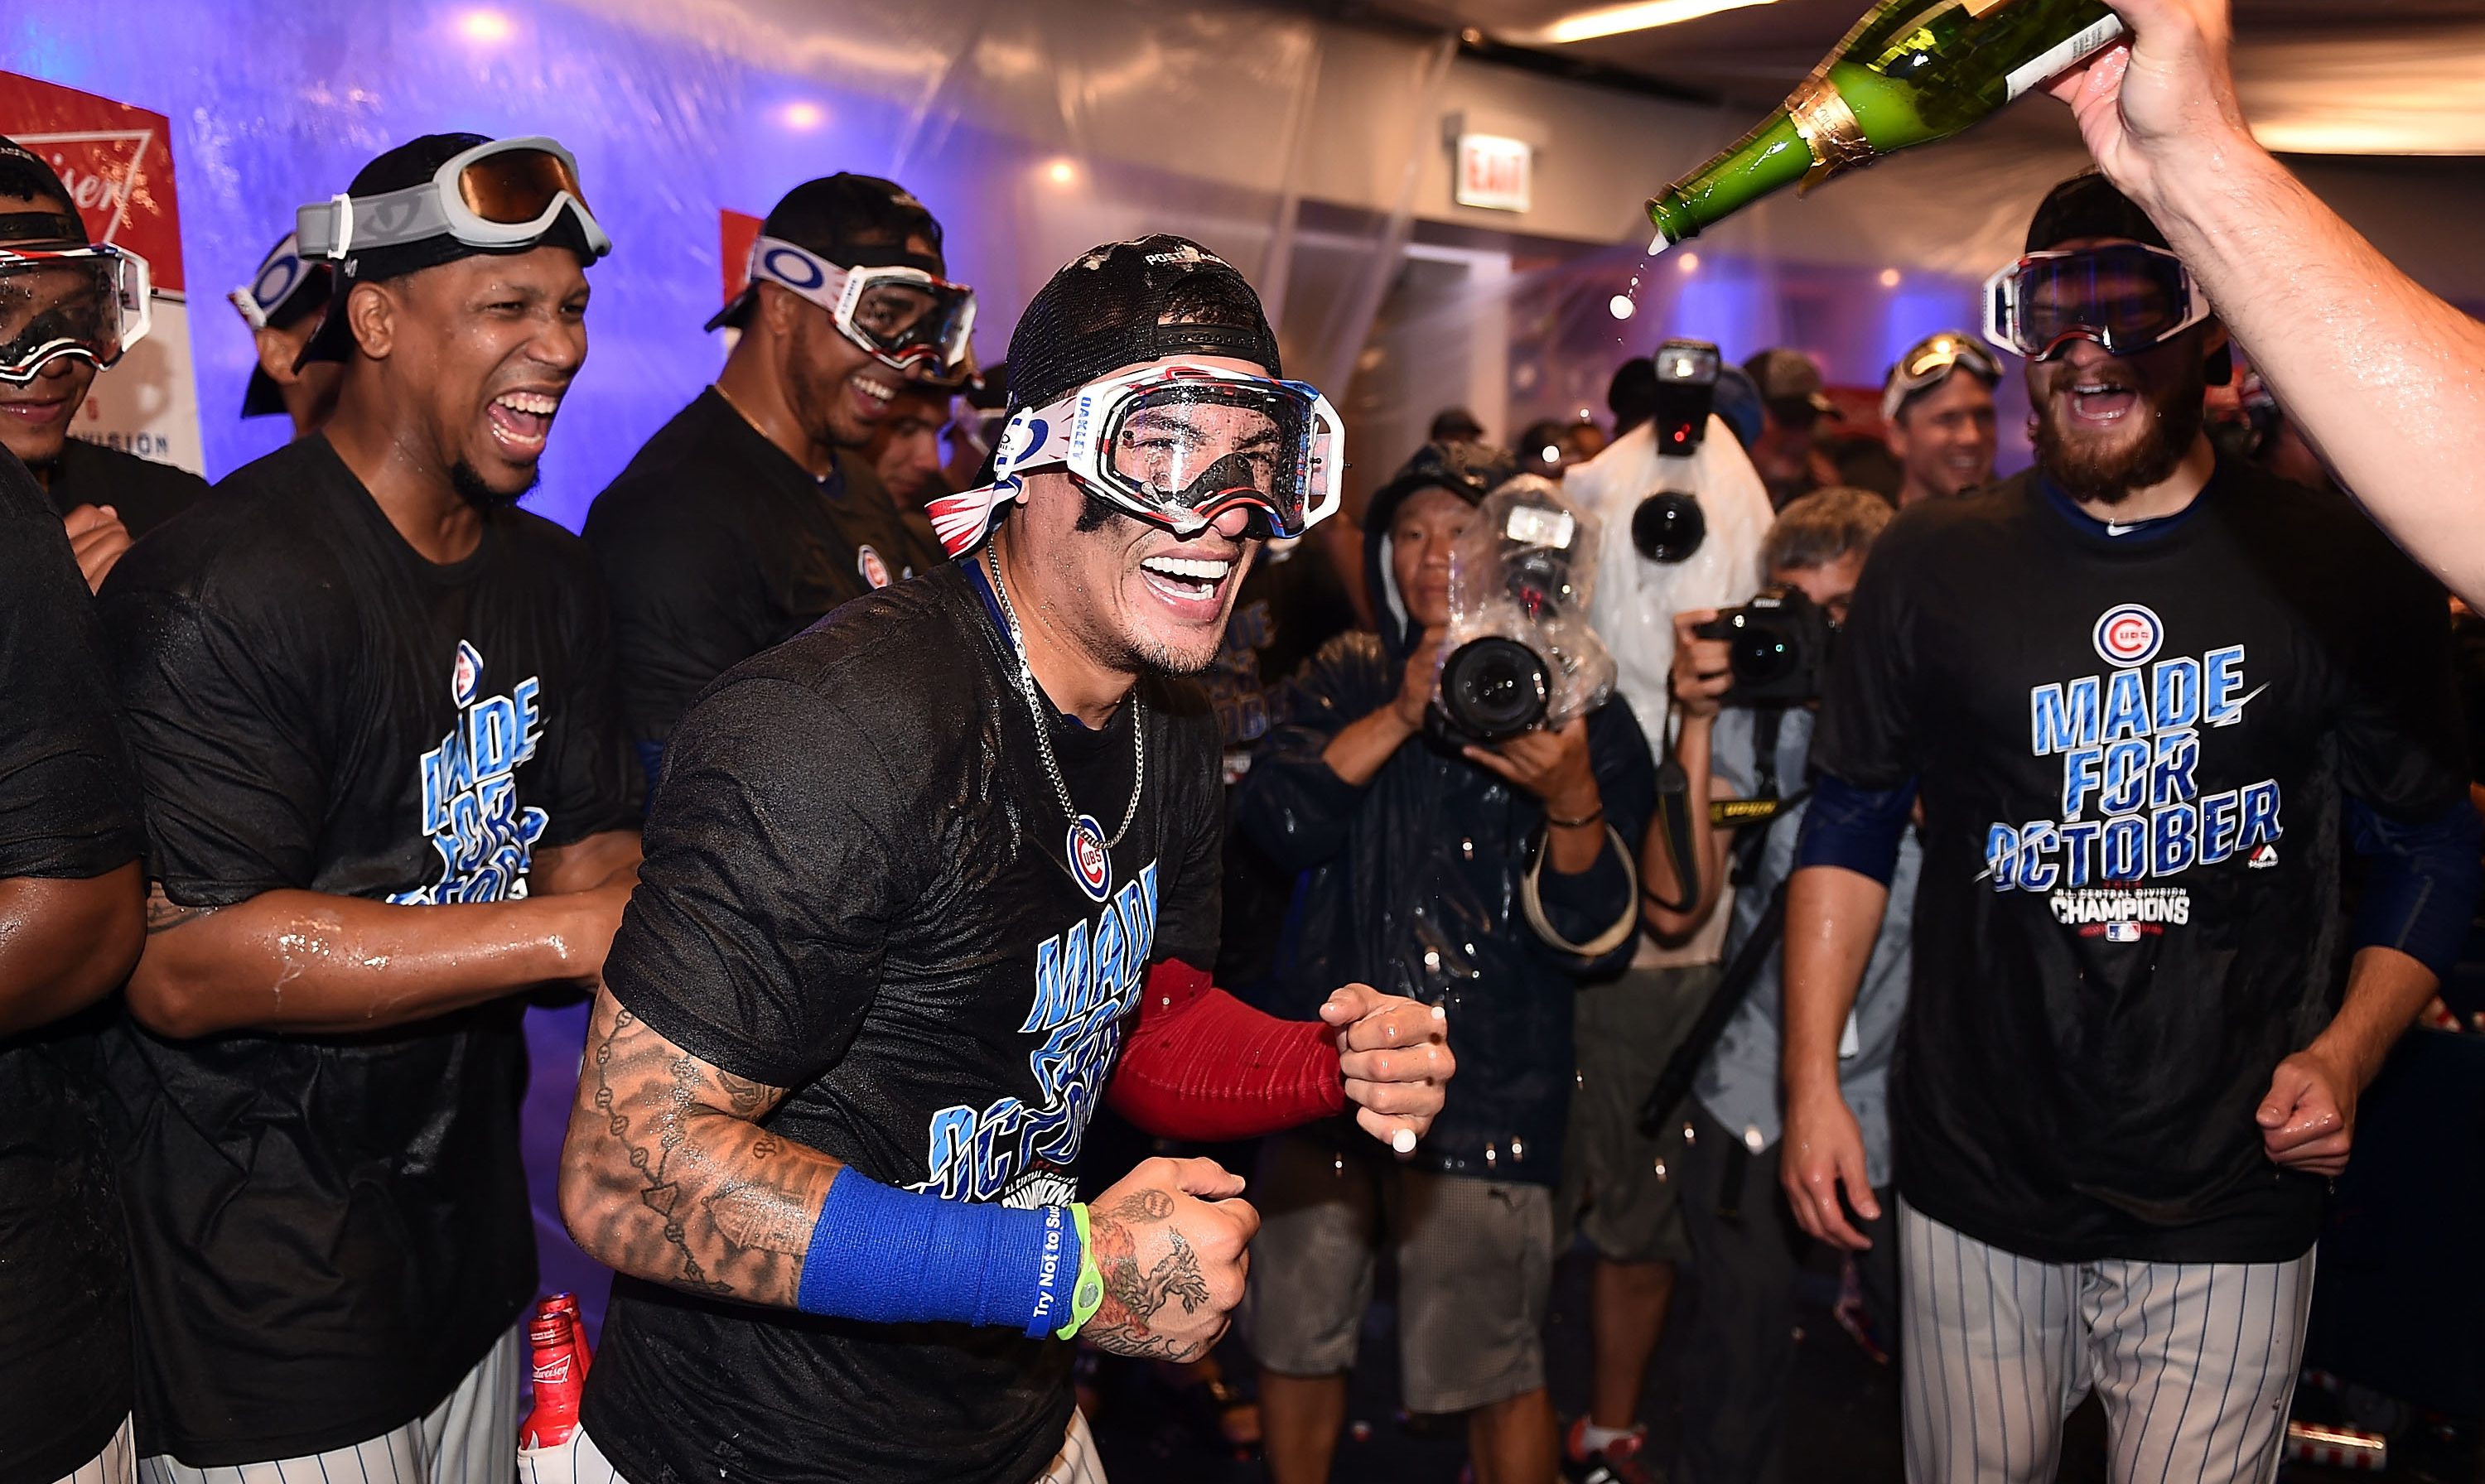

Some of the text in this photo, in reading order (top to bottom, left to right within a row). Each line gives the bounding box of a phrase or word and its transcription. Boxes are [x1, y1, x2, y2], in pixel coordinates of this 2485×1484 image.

[1073, 397, 1092, 460] OAKLEY
[2031, 644, 2246, 757] MADE
[2062, 727, 2200, 822] FOR
[1983, 778, 2284, 893] OCTOBER
[2078, 889, 2131, 899] CENTRAL
[2135, 888, 2187, 898] DIVISION
[2049, 895, 2190, 925] CHAMPIONS
[1045, 1232, 1060, 1250] to
[1039, 1254, 1059, 1286] Not
[1033, 1291, 1054, 1318] Try
